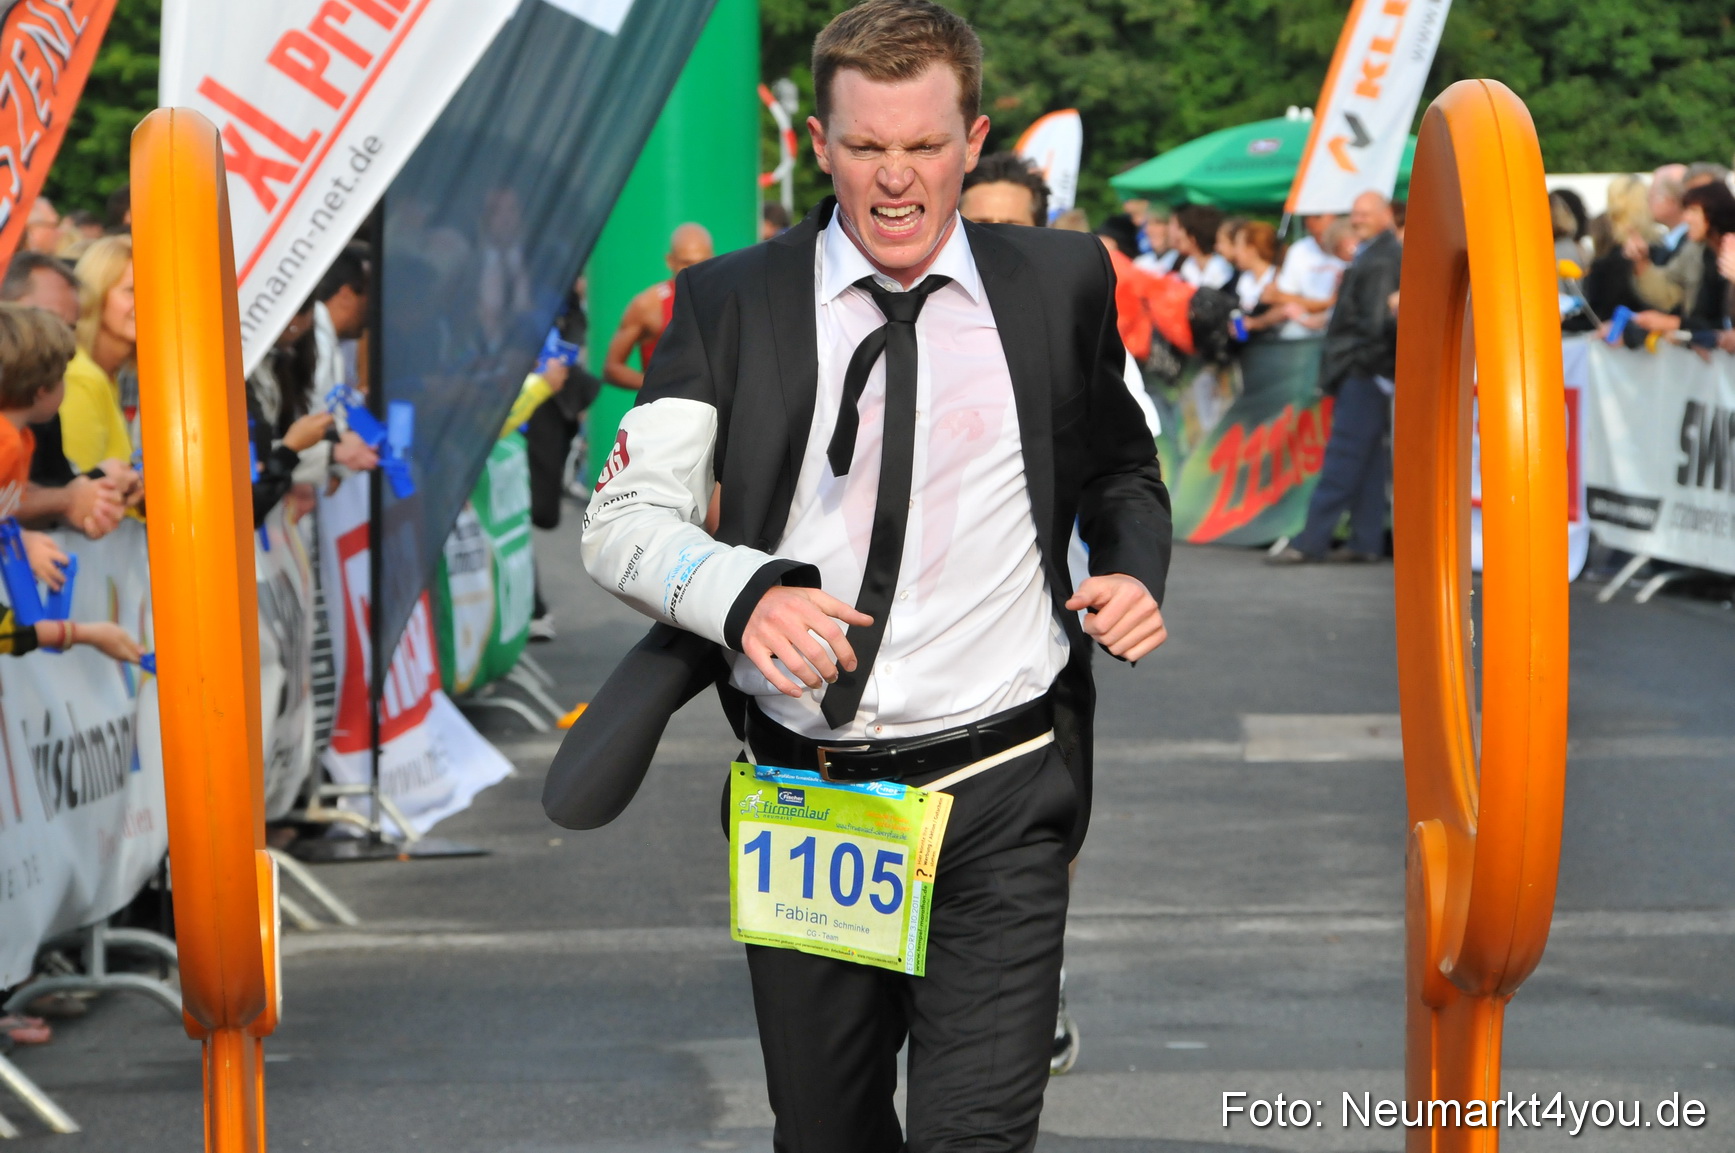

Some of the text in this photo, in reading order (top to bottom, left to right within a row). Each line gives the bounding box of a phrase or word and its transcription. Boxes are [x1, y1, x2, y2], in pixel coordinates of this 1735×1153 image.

[196, 75, 322, 214] XL
[617, 544, 645, 593] powered
[630, 568, 640, 582] by
[763, 801, 831, 821] firmenlauf
[744, 830, 904, 915] 1105
[775, 903, 870, 935] Fabian Schminke
[806, 929, 817, 938] CG
[822, 931, 839, 941] Team
[906, 934, 916, 971] ETSDORF
